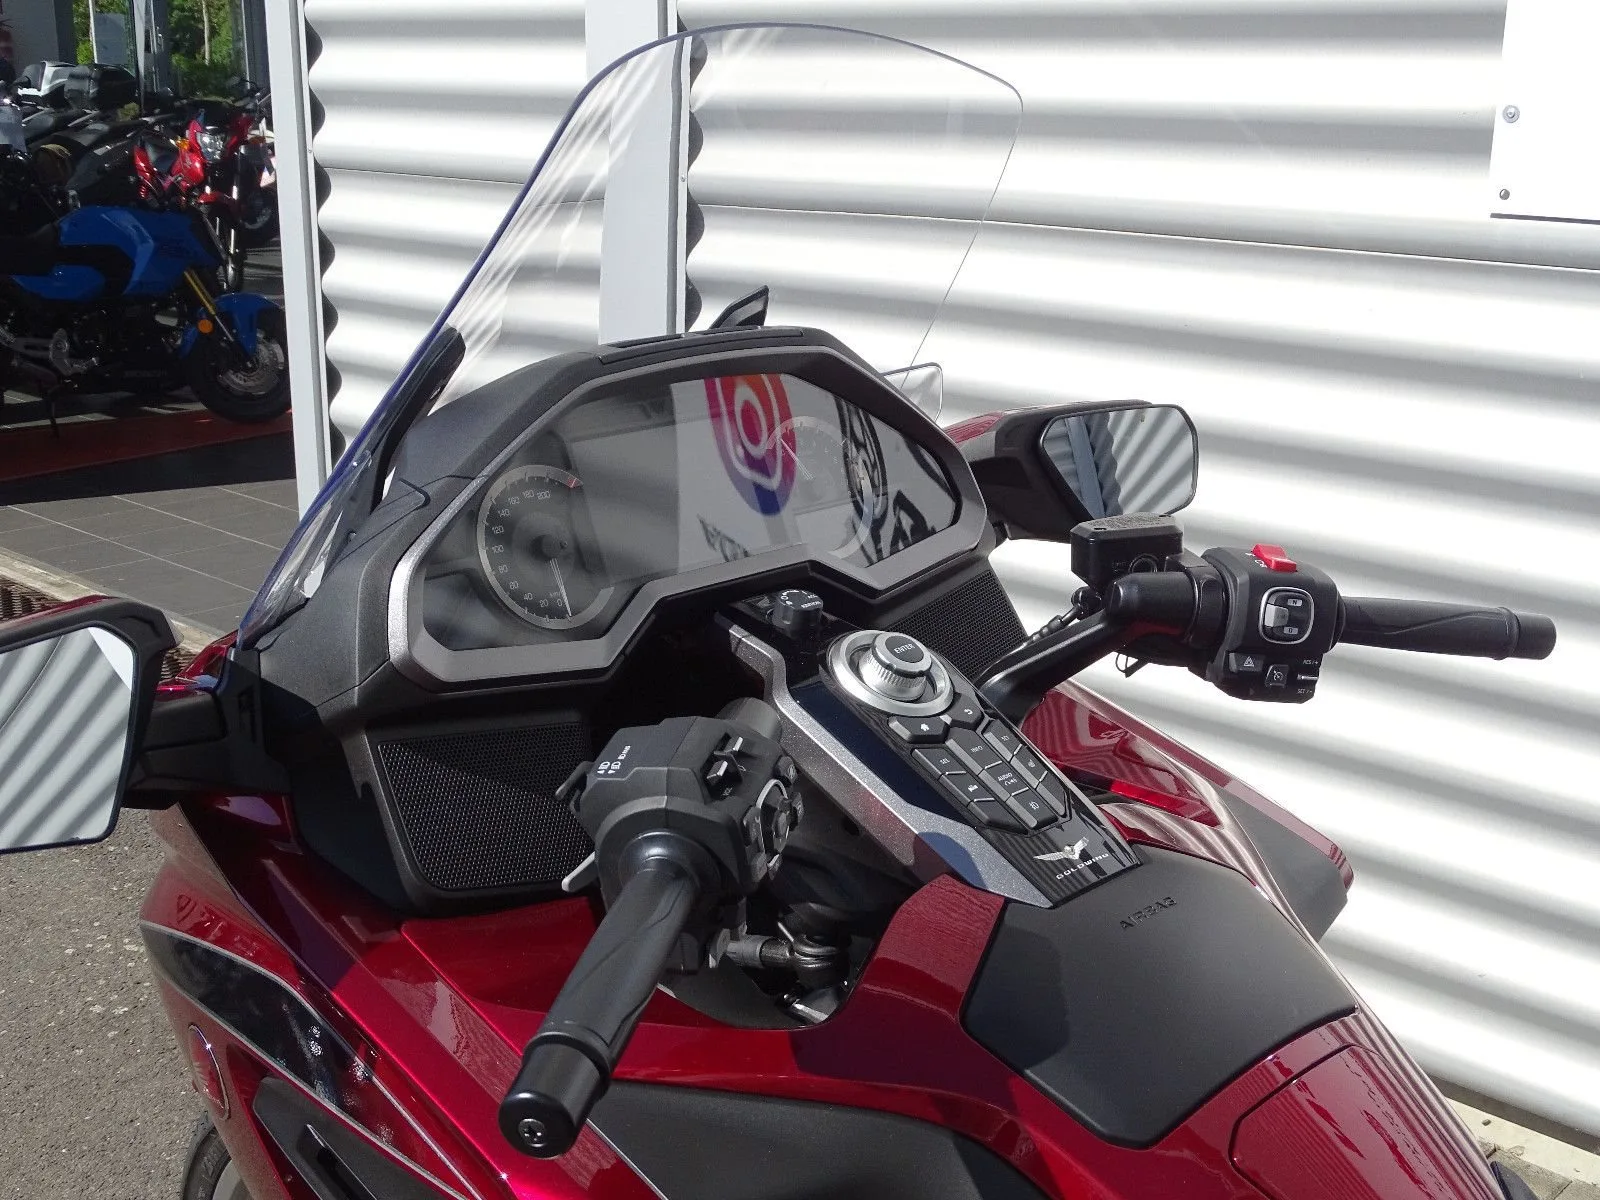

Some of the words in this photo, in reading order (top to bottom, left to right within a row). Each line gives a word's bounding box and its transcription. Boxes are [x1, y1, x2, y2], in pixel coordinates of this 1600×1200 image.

[492, 525, 504, 534] 120
[523, 592, 533, 601] 40
[540, 598, 549, 607] 20
[893, 643, 916, 654] ENTER
[1055, 852, 1110, 880] GOLDWING
[1119, 896, 1178, 930] AIRBAG
